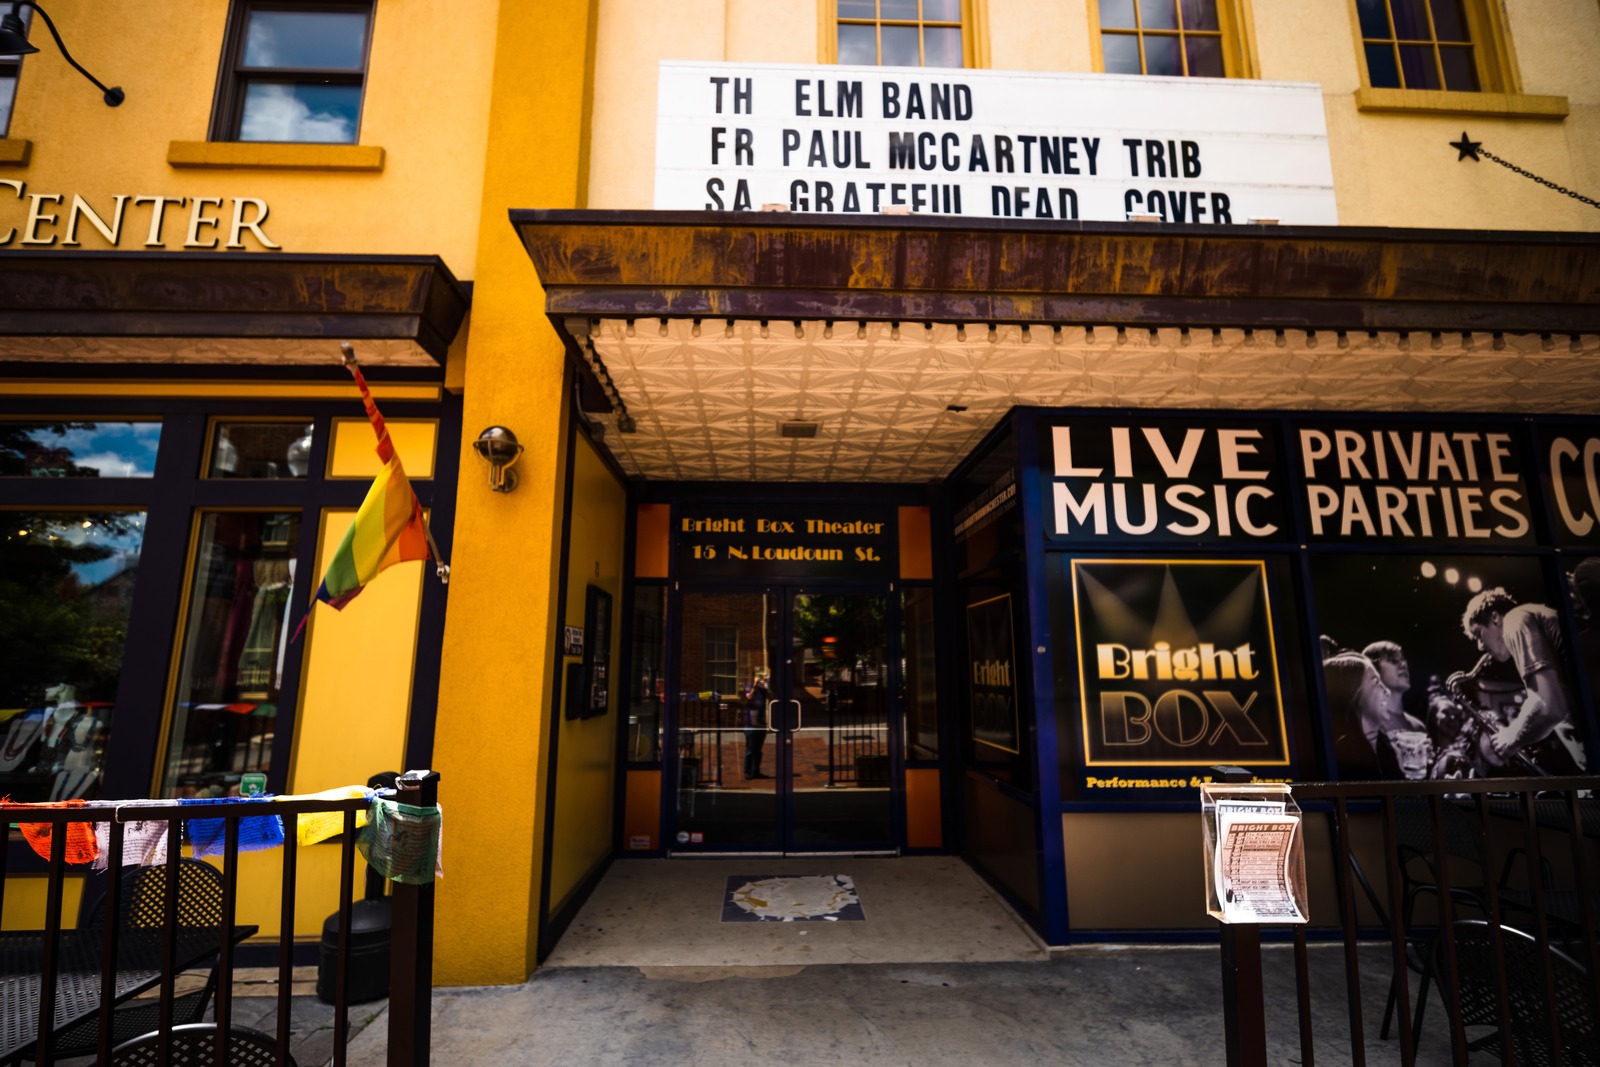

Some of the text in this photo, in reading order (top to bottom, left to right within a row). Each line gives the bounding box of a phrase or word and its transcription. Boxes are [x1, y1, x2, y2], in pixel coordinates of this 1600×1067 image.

[709, 76, 973, 121] TH ELM BAND
[711, 127, 1202, 179] FR PAUL MCCARTNEY TRIB
[0, 178, 282, 249] CENTER
[705, 178, 752, 212] SA
[1051, 426, 1271, 480] LIVE
[1299, 429, 1520, 482] PRIVATE
[681, 517, 885, 535] Bright Box Theater
[1052, 482, 1279, 537] MUSIC
[1306, 484, 1530, 538] PARTIES
[692, 544, 717, 560] 15
[752, 545, 843, 561] Loudoun
[855, 546, 881, 562] St.
[1096, 641, 1260, 682] Bright
[1100, 689, 1269, 747] BOX
[1086, 776, 1187, 788] Performance
[1190, 777, 1202, 788] &
[1231, 824, 1293, 832] BRIGHT BOX
